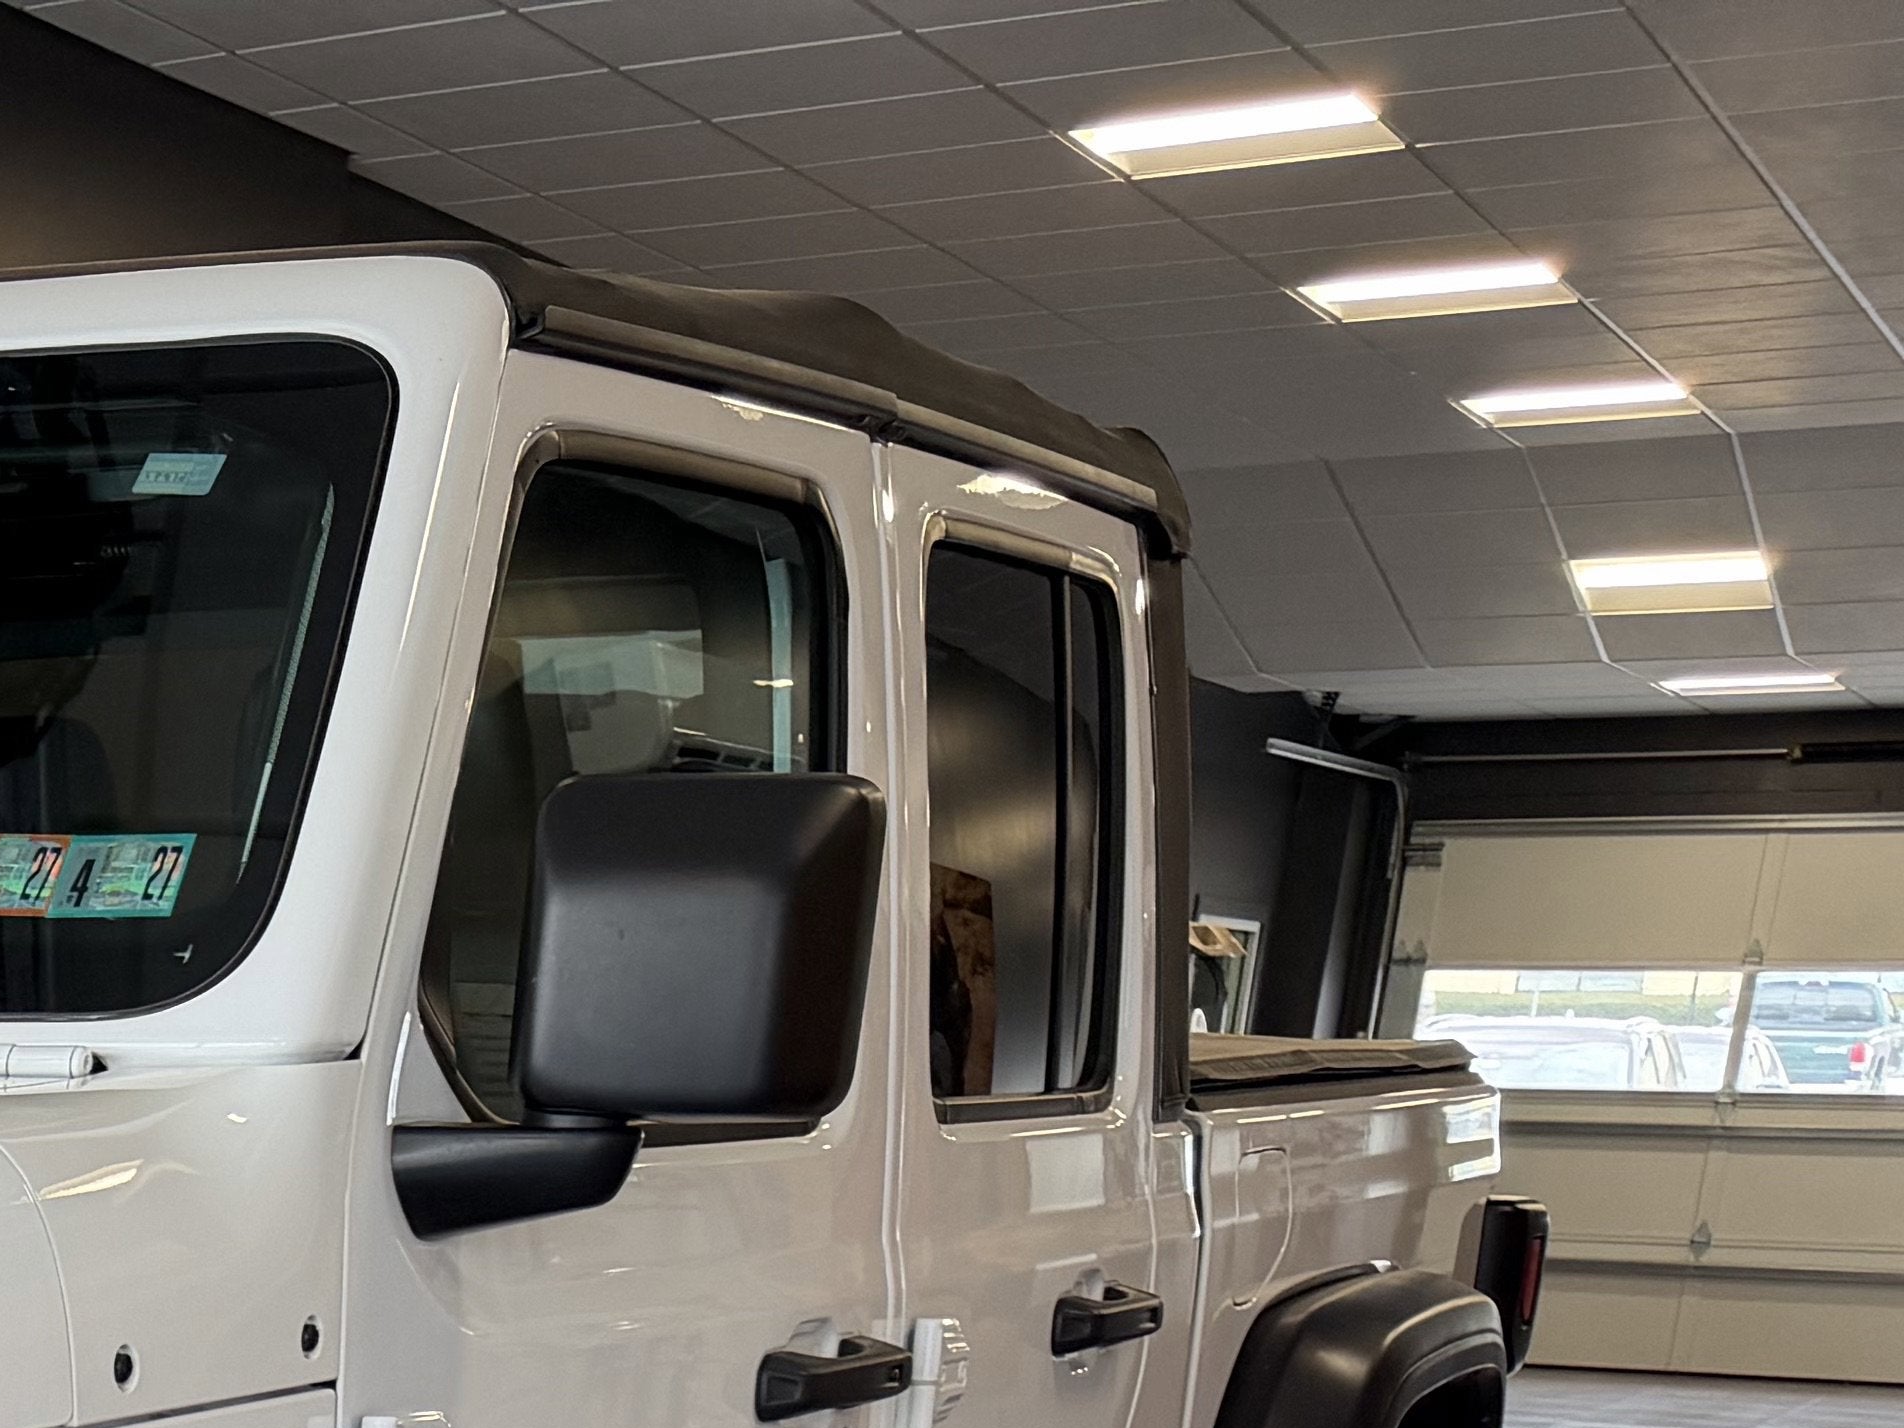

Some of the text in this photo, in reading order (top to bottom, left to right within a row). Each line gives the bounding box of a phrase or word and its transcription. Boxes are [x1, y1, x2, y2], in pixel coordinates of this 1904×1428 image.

[19, 846, 63, 907] 27
[70, 845, 184, 908] 4 27
